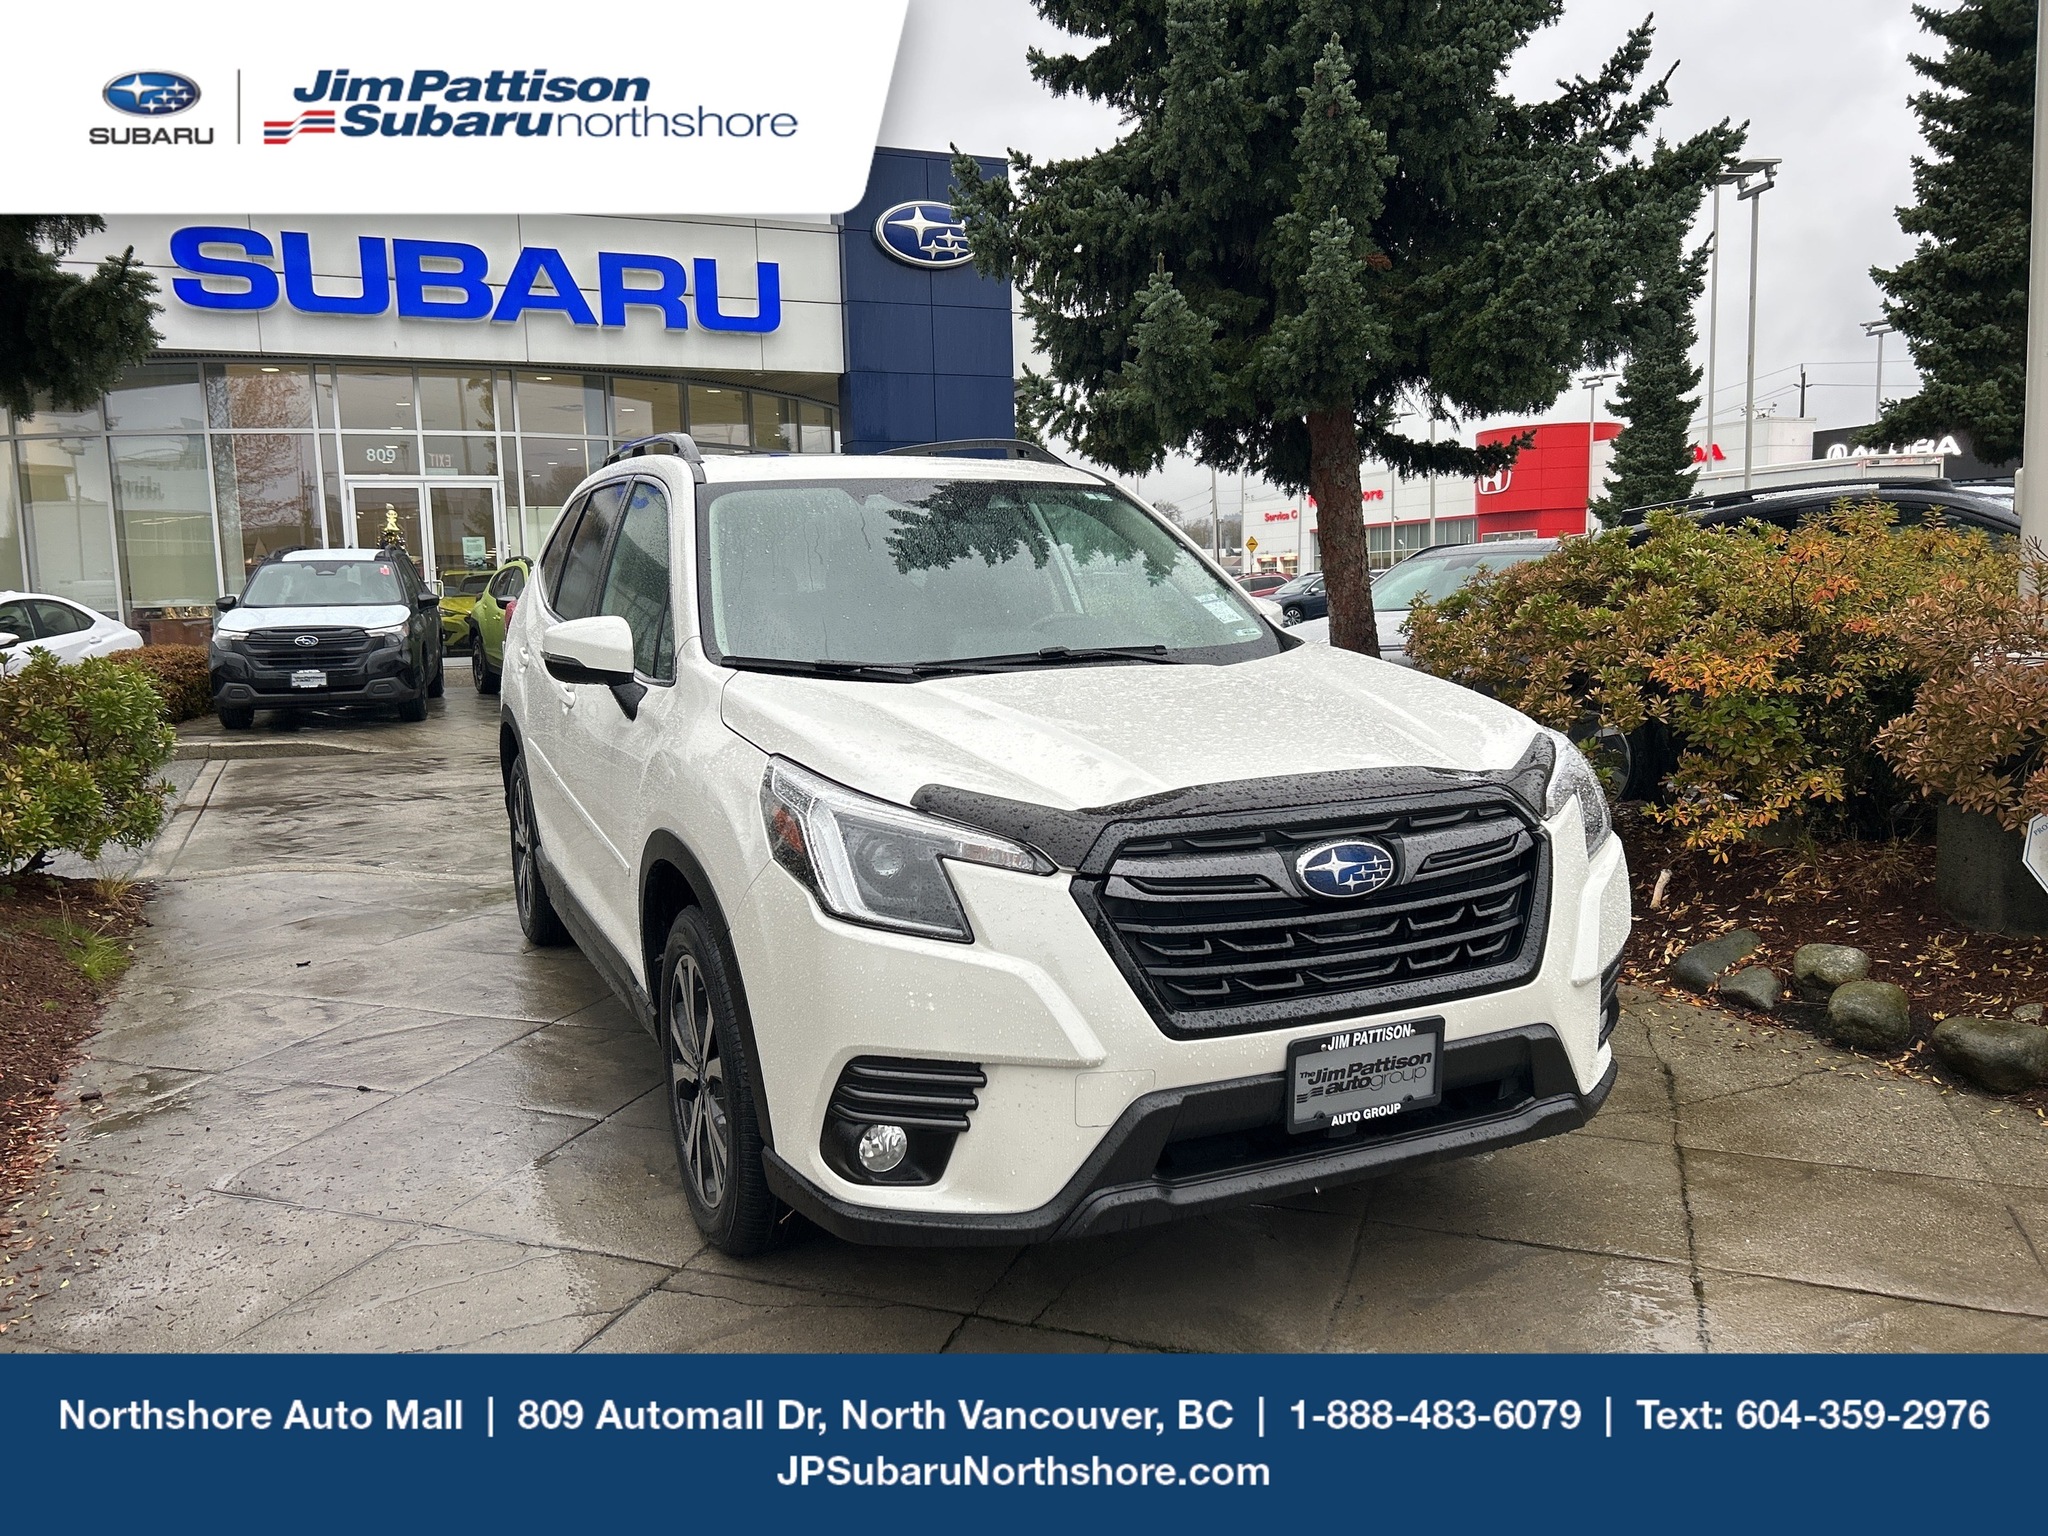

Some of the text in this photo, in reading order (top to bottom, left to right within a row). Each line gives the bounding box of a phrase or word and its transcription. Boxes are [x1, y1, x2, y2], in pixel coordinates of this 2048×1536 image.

[170, 226, 782, 335] SUBARU
[366, 448, 396, 462] 809
[1264, 511, 1290, 522] Service
[1327, 1023, 1411, 1051] JIM PATTISON
[1299, 1052, 1432, 1085] The Jim Pattison
[1331, 1102, 1401, 1126] AUTO GROUP
